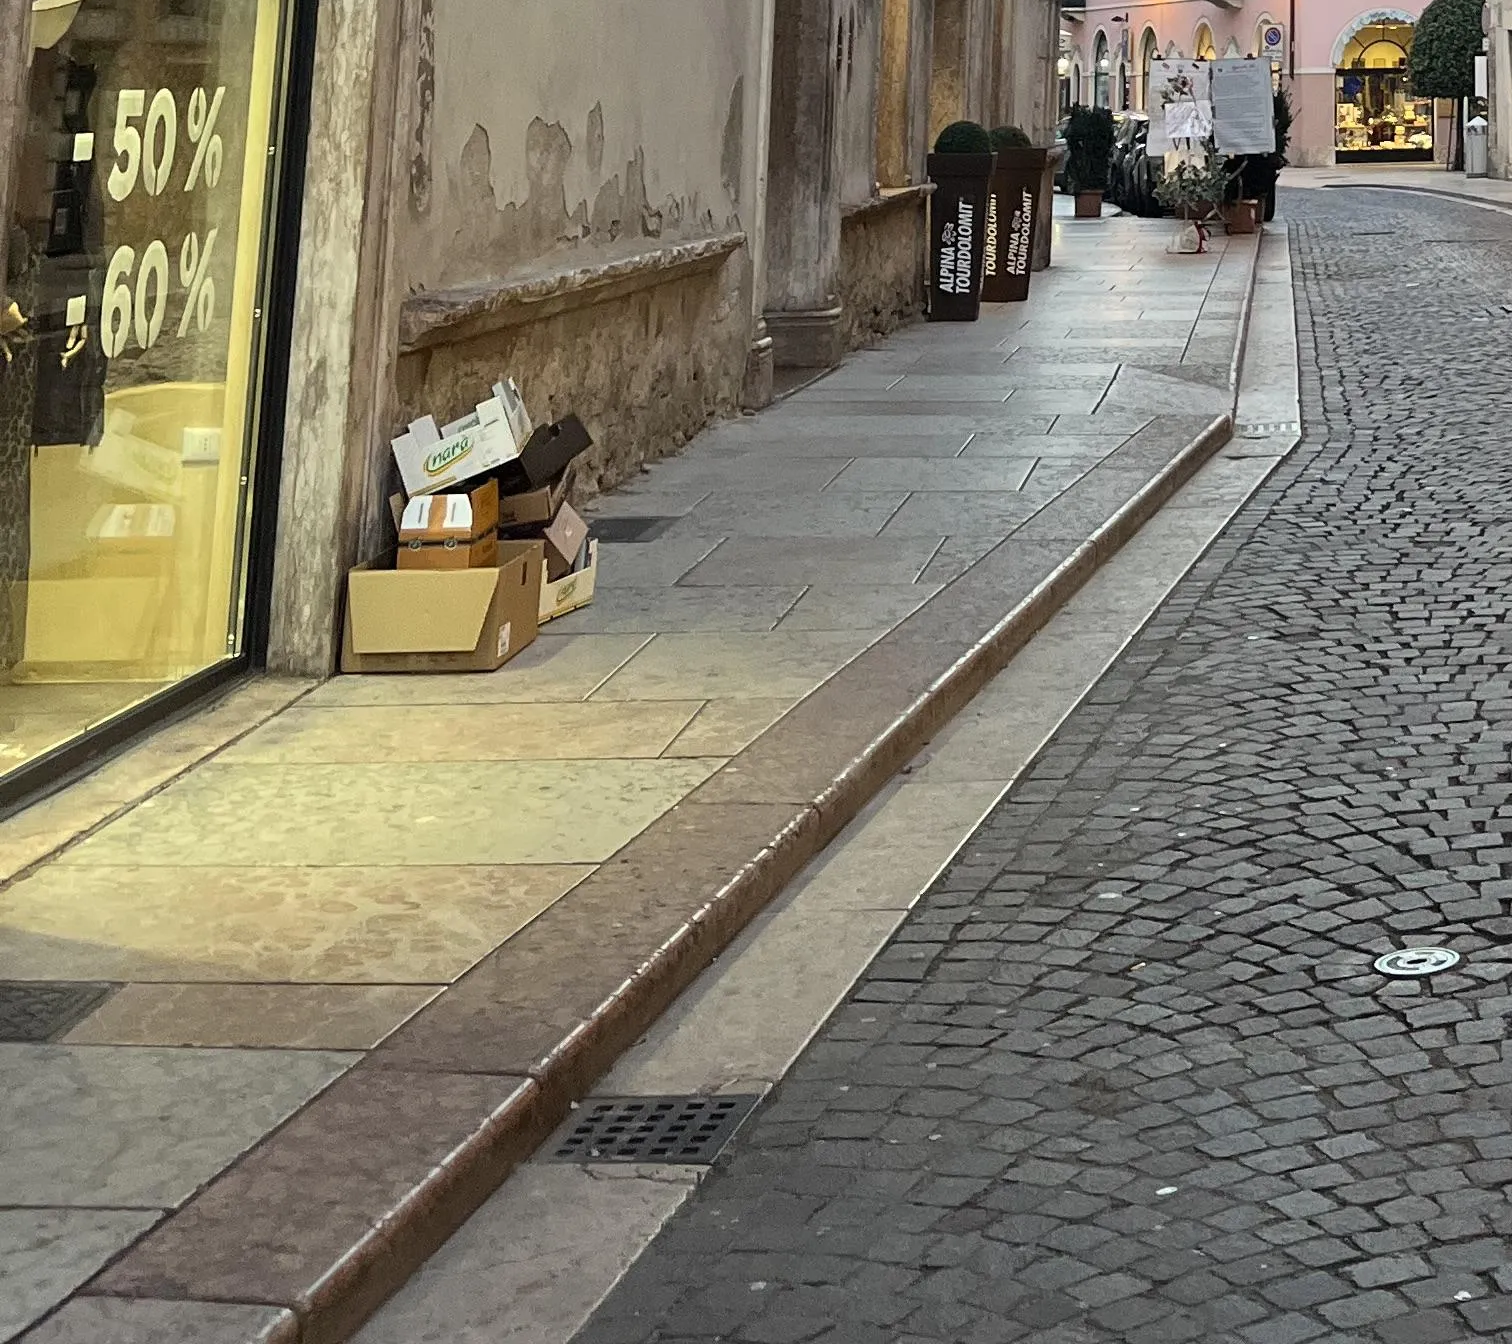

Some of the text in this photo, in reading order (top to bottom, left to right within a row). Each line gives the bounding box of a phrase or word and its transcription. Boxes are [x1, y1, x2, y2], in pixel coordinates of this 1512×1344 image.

[955, 201, 974, 294] TOURDOLOMIT
[1006, 232, 1021, 275] ALPINA
[1015, 191, 1033, 276] TOURDOLOMIT
[939, 246, 956, 293] ALPINA
[431, 436, 469, 468] nara
